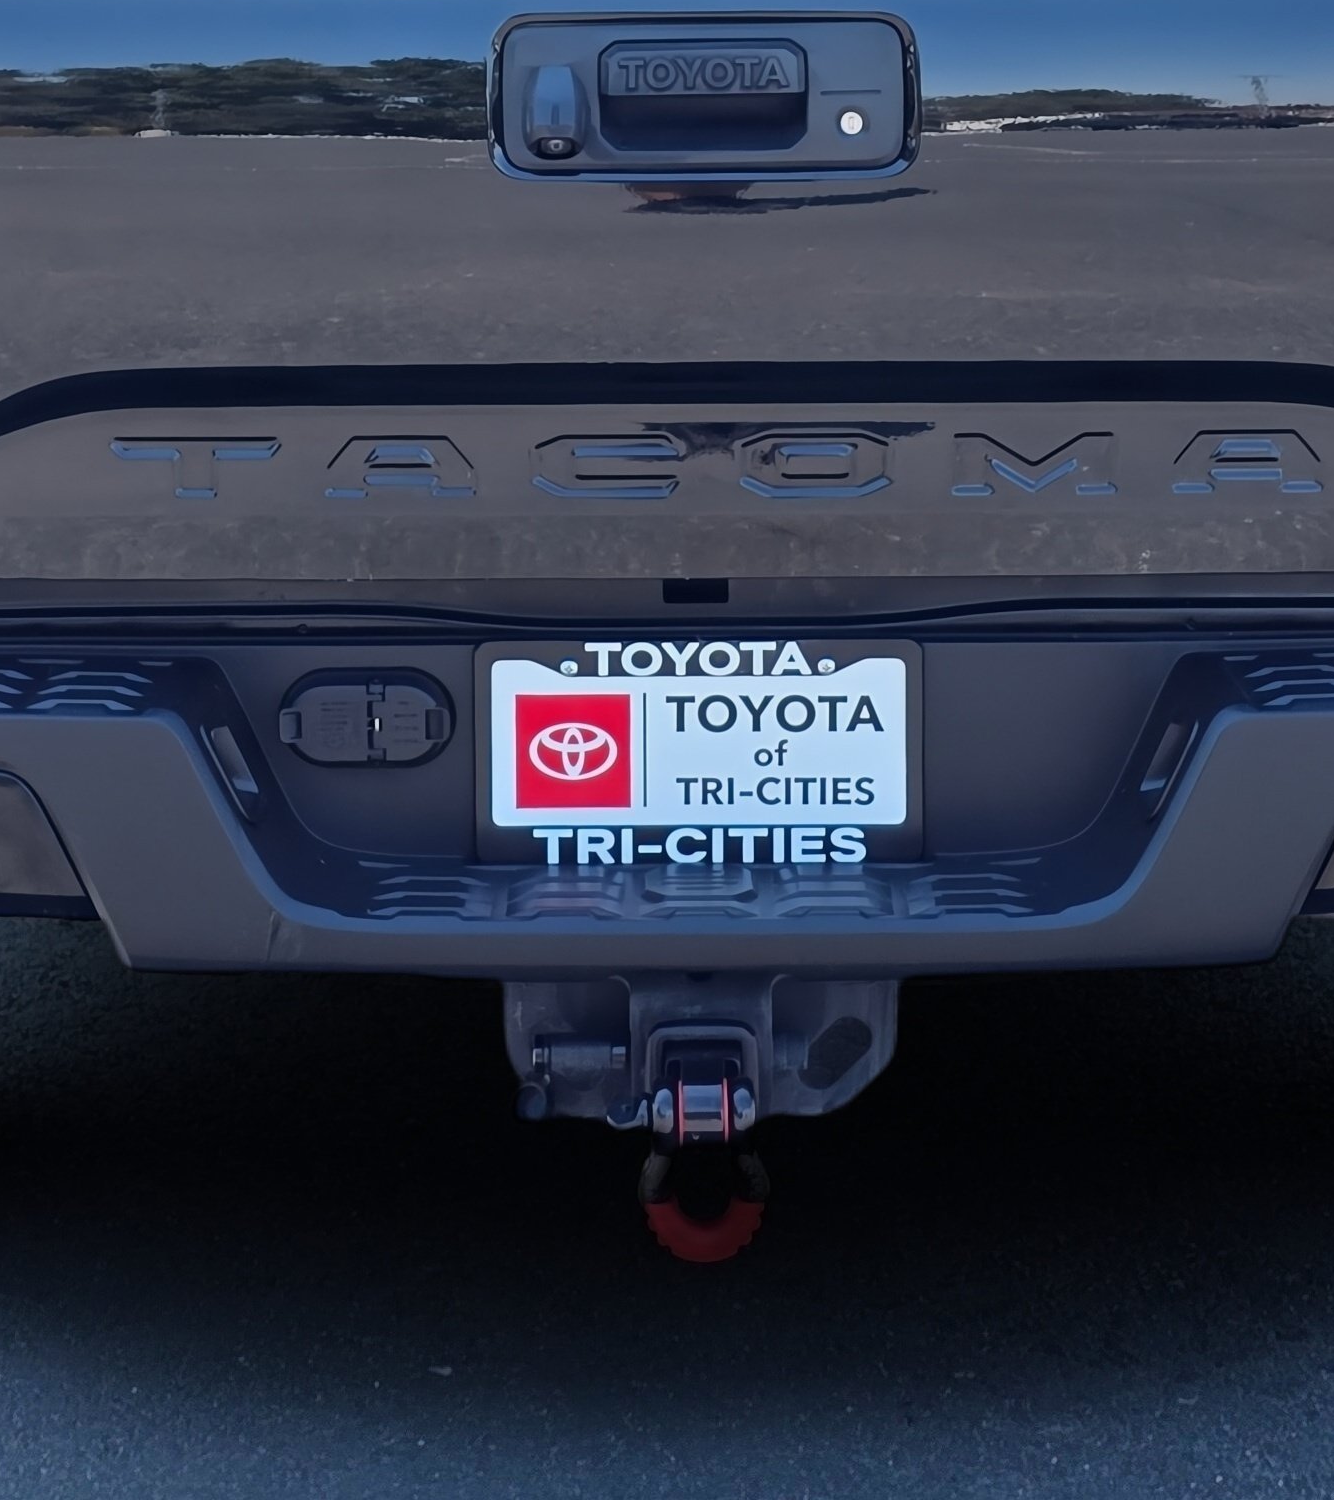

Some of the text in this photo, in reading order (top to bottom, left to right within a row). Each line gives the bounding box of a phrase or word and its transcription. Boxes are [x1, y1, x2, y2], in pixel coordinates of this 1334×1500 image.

[618, 56, 789, 90] TOYOTA
[109, 429, 1323, 499] TACOMA
[584, 641, 813, 677] TOYOTA
[665, 695, 885, 733] TOYOTA
[754, 739, 789, 767] of
[676, 777, 875, 806] TRI-CITIES
[533, 827, 867, 865] TRI-CITIES
